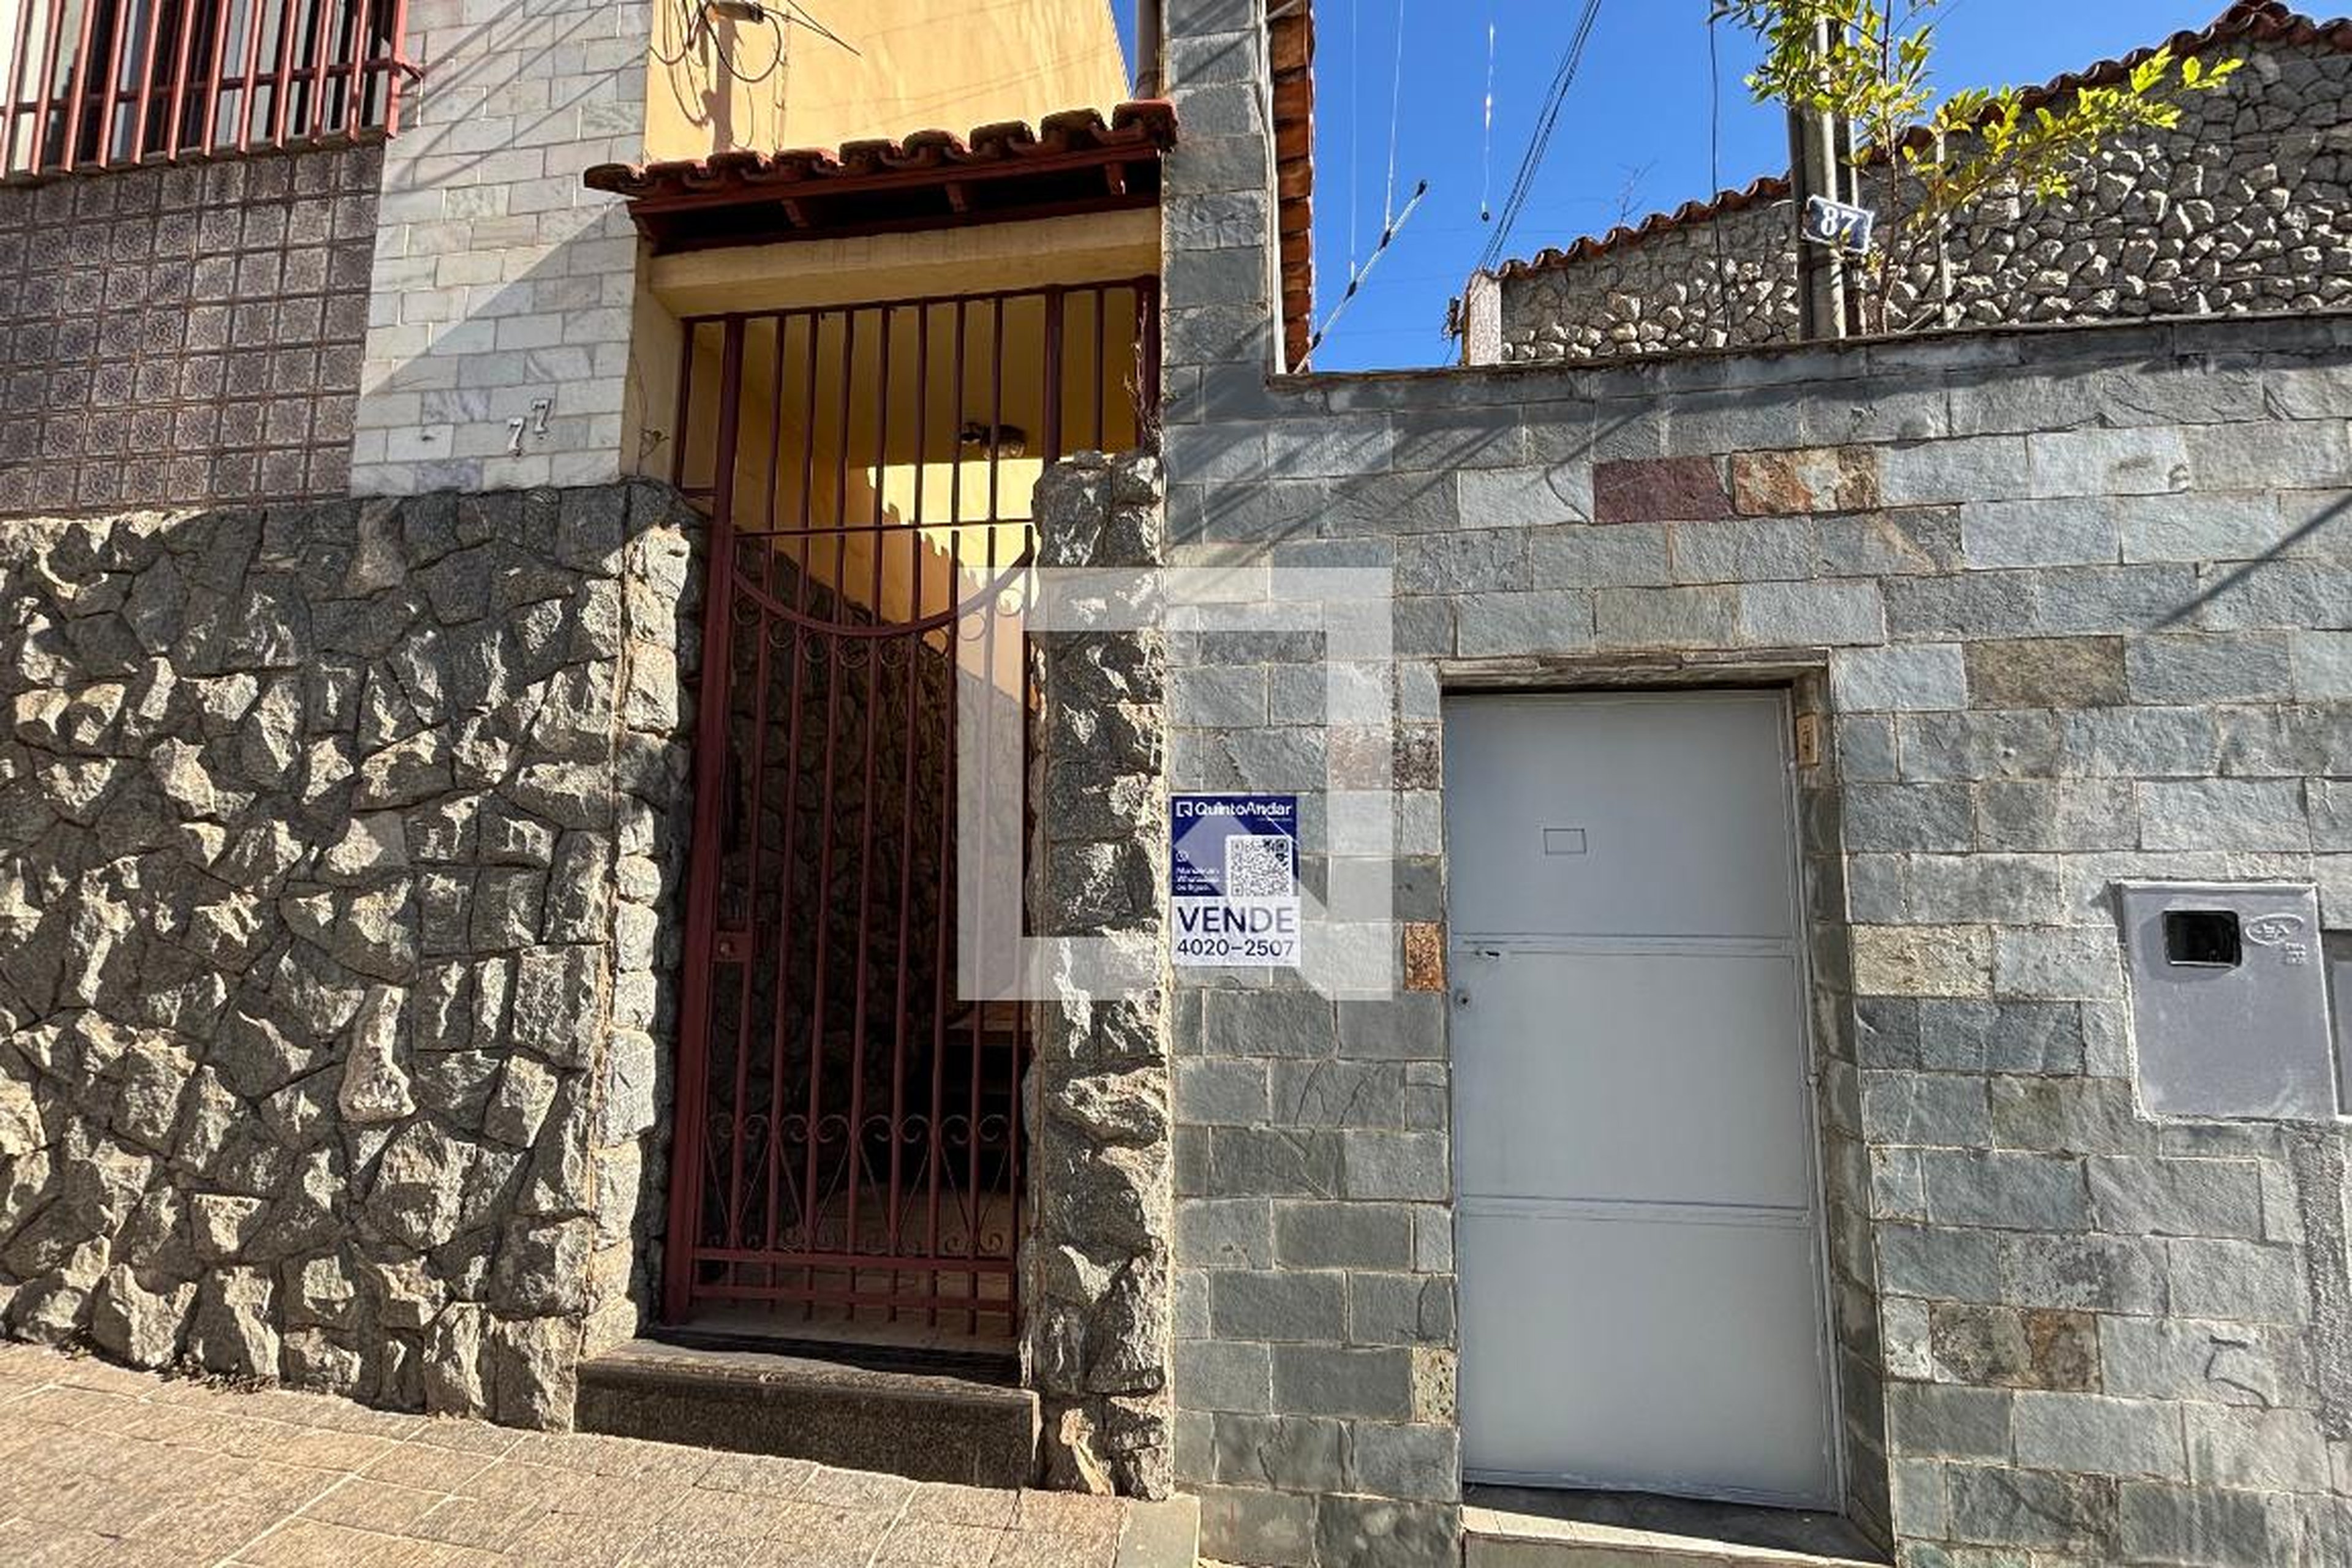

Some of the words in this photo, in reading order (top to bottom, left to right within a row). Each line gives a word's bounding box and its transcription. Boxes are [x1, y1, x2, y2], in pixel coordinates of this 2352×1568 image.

[1820, 206, 1859, 241] 87
[506, 398, 551, 454] 77
[1195, 801, 1292, 816] QuintoAndar
[1177, 907, 1295, 933] VENDE
[1177, 938, 1294, 957] 4020-2507
